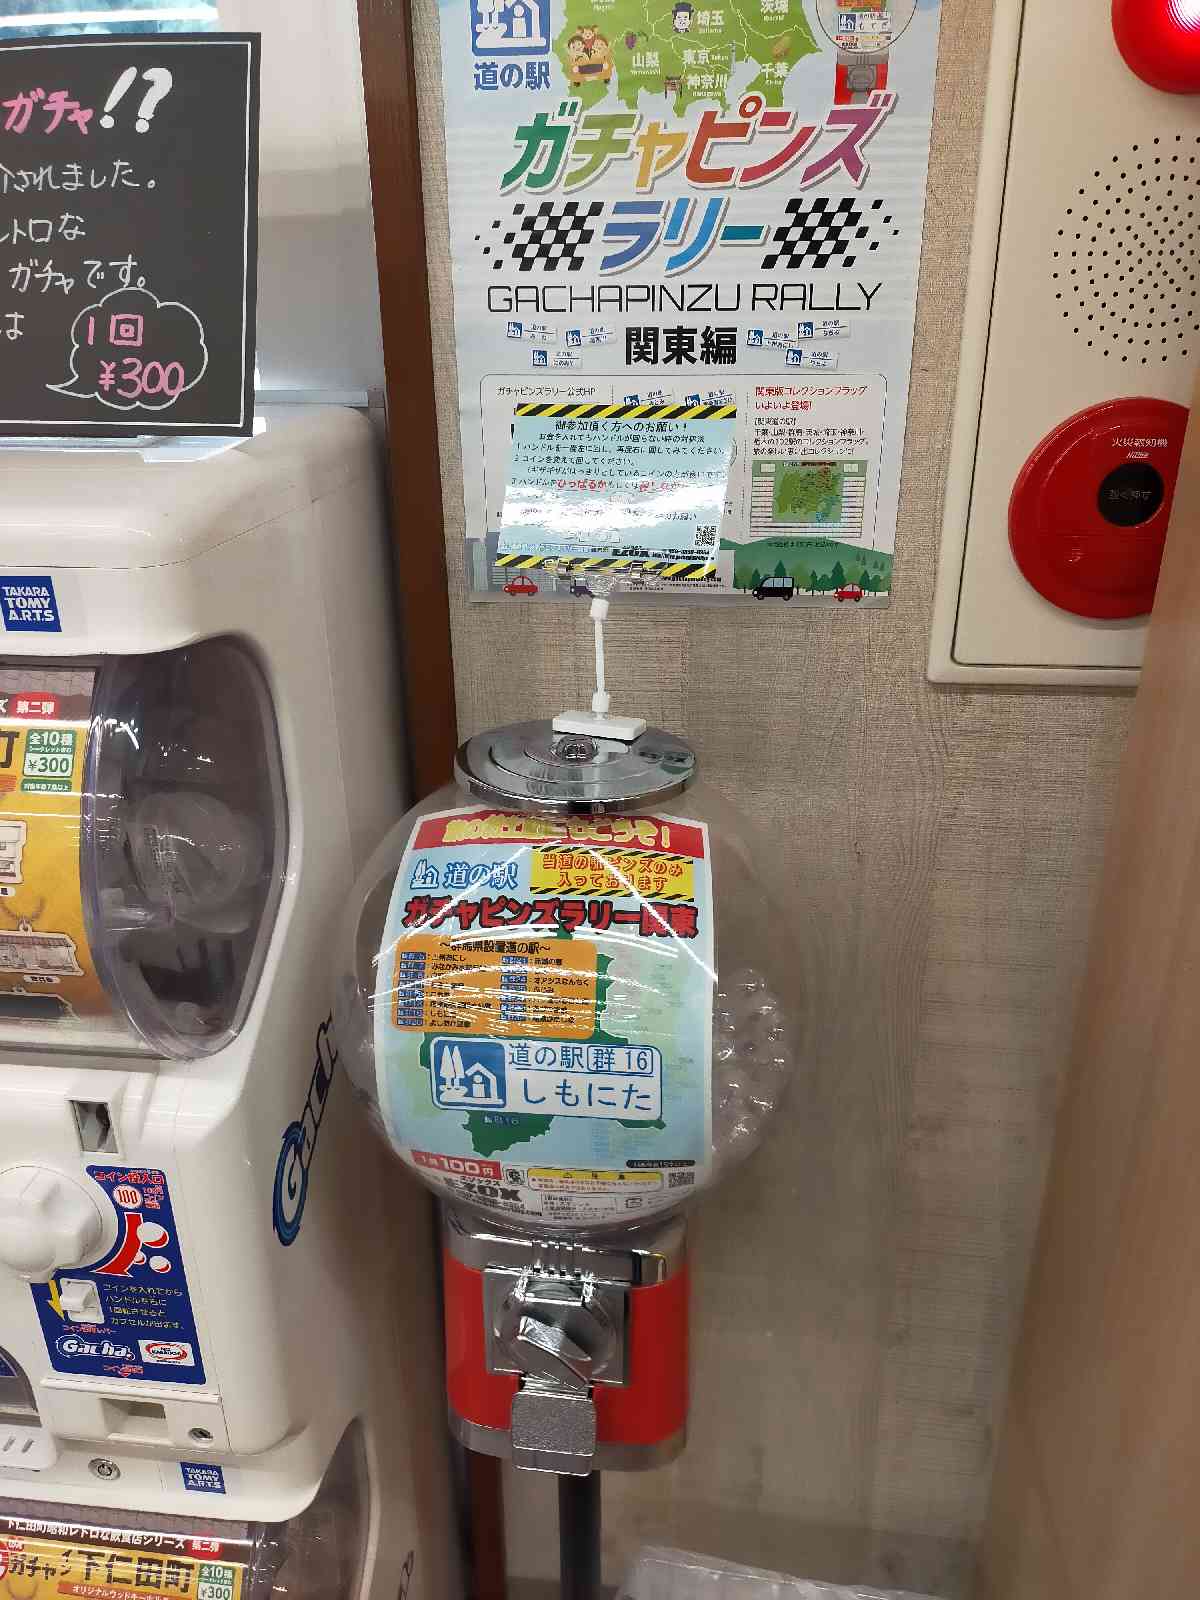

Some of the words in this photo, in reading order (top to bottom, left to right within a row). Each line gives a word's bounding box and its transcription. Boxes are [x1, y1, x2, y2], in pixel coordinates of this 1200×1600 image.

[696, 10, 725, 27] 埼玉
[632, 52, 659, 67] 山梨
[682, 49, 709, 65] 東京
[473, 62, 550, 90] 道の駅
[760, 63, 788, 78] 千葉
[687, 73, 728, 90] 神奈川
[500, 92, 898, 193] ガチャピンズ
[599, 197, 769, 278] ラリー
[9, 254, 147, 293] ガチャです。
[487, 284, 741, 313] GACHAPINZU
[751, 282, 882, 311] RALLY
[86, 314, 144, 347] 1回
[625, 325, 738, 366] 関東編
[98, 357, 185, 397] ¥300
[3, 586, 49, 597] TAKARA
[7, 597, 51, 609] TOMY
[16, 700, 55, 715] 第二弾
[29, 731, 73, 746] 全10種
[28, 757, 70, 773] ¥300
[443, 862, 519, 890] 道の駅
[508, 1043, 584, 1069] 道の駅
[592, 1048, 616, 1072] 群
[624, 1050, 648, 1072] 16
[522, 1078, 652, 1111] しもにた
[117, 1188, 139, 1207] 100
[185, 1467, 218, 1476] TAKARA
[188, 1474, 219, 1483] TOMY
[77, 1550, 194, 1593] 下仁田町
